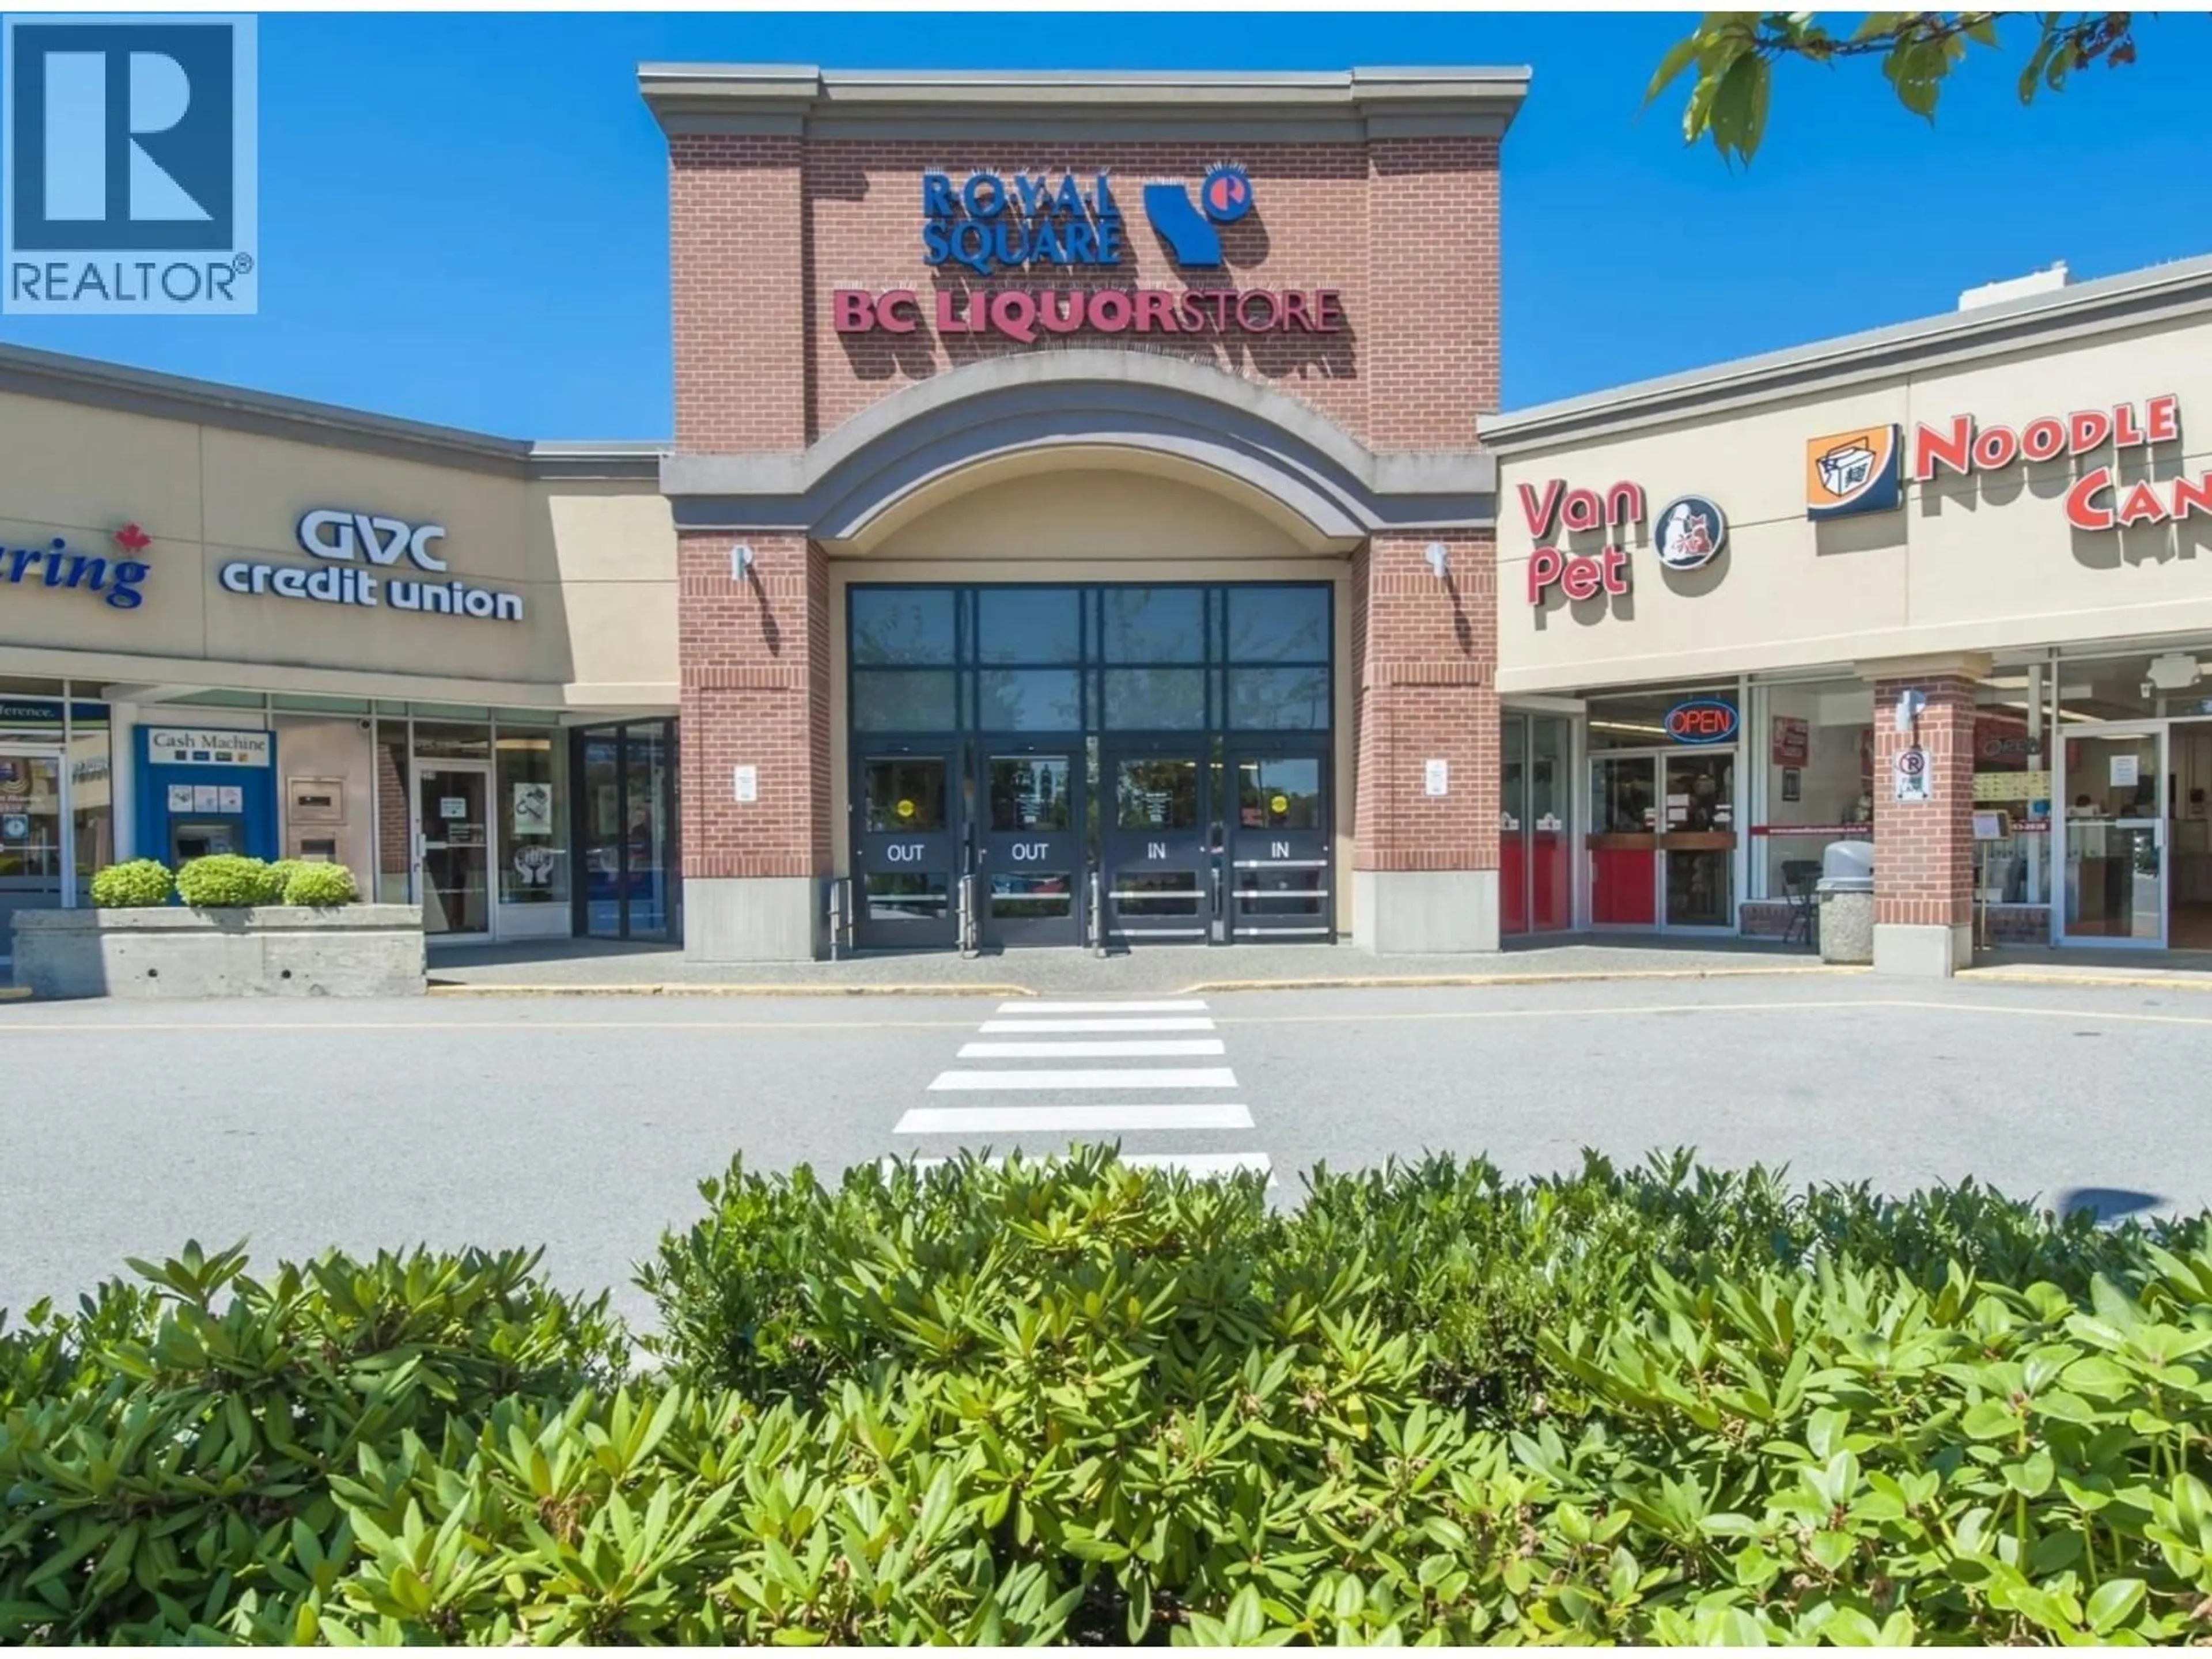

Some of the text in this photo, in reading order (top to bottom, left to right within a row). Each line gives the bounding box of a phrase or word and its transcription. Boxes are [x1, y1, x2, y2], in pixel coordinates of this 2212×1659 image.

[923, 173, 1120, 219] ROYAL
[922, 220, 1120, 275] SQUARE
[834, 289, 917, 333] BC
[1914, 393, 2177, 482] NOODLE
[1517, 479, 1645, 540] Van
[0, 537, 151, 609] ring
[221, 562, 523, 621] credit union
[1527, 545, 1628, 606] Pet
[153, 732, 266, 751] Cash Machine
[1671, 710, 1732, 734] OPEN
[887, 844, 925, 862] OUT
[1012, 843, 1050, 861] OUT
[1147, 843, 1166, 859] IN
[1271, 842, 1289, 858] IN
